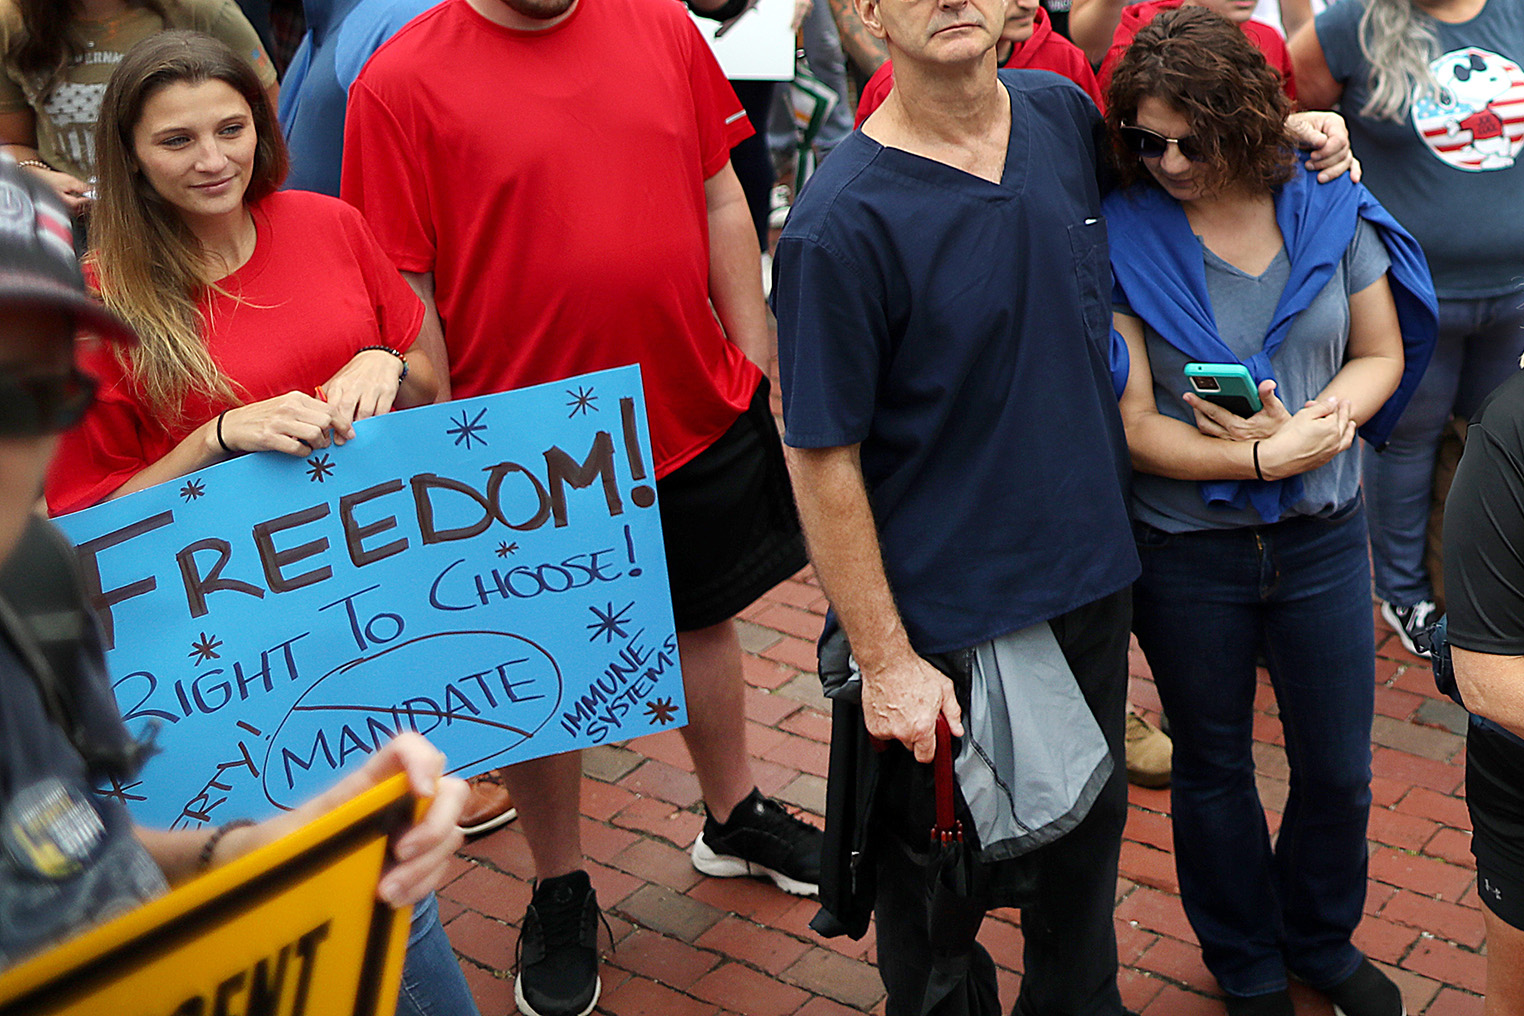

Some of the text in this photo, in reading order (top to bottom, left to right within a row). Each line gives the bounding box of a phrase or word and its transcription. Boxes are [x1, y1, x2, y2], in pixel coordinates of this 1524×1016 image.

[76, 396, 657, 651] FREEDOM!
[112, 632, 311, 725] RIGHT
[428, 525, 643, 611] CHOOSE!
[560, 627, 656, 738] IMMUNE
[586, 633, 677, 744] SYSTEMS
[281, 657, 546, 791] MANDATE
